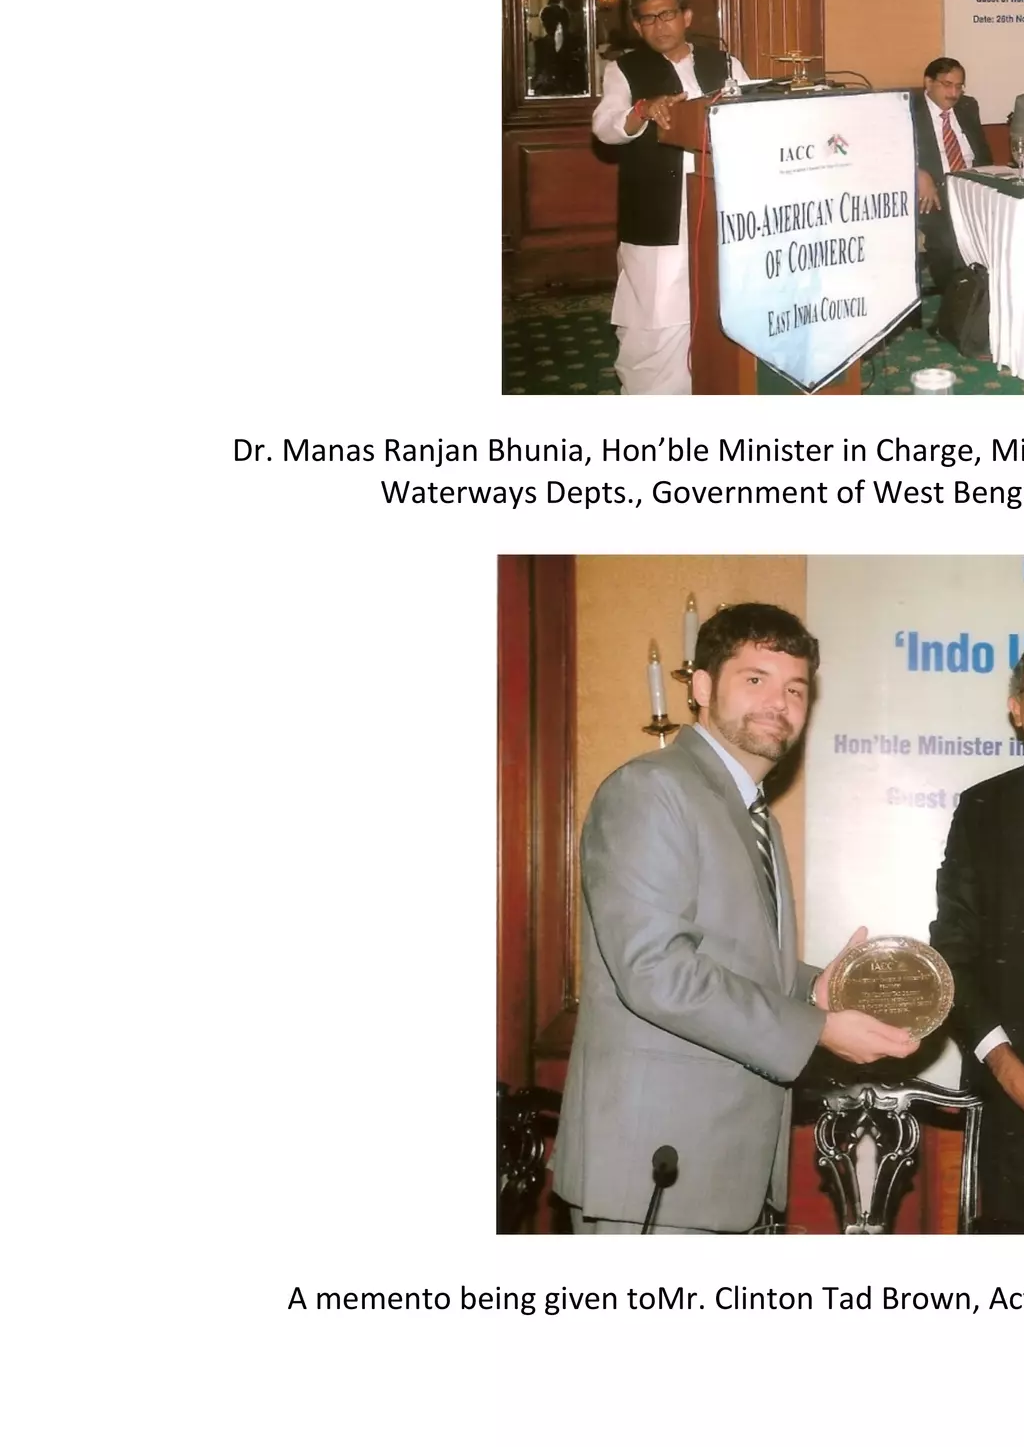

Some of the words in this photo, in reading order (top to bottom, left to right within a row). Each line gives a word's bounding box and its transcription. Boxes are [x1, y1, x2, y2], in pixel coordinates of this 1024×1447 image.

[380, 480, 537, 510] Waterways
[547, 480, 642, 510] Depts.,
[652, 480, 828, 504] Government
[836, 478, 866, 504] of
[872, 480, 945, 504] West
[918, 734, 1002, 757] Minister
[287, 1286, 308, 1310] A
[316, 1288, 451, 1310] memento
[461, 1285, 537, 1316] being
[544, 1286, 617, 1316] given
[626, 1286, 705, 1310] toMr.
[715, 1284, 813, 1310] Clinton
[821, 1285, 872, 1310] Tad
[883, 1286, 980, 1315] Brown,
